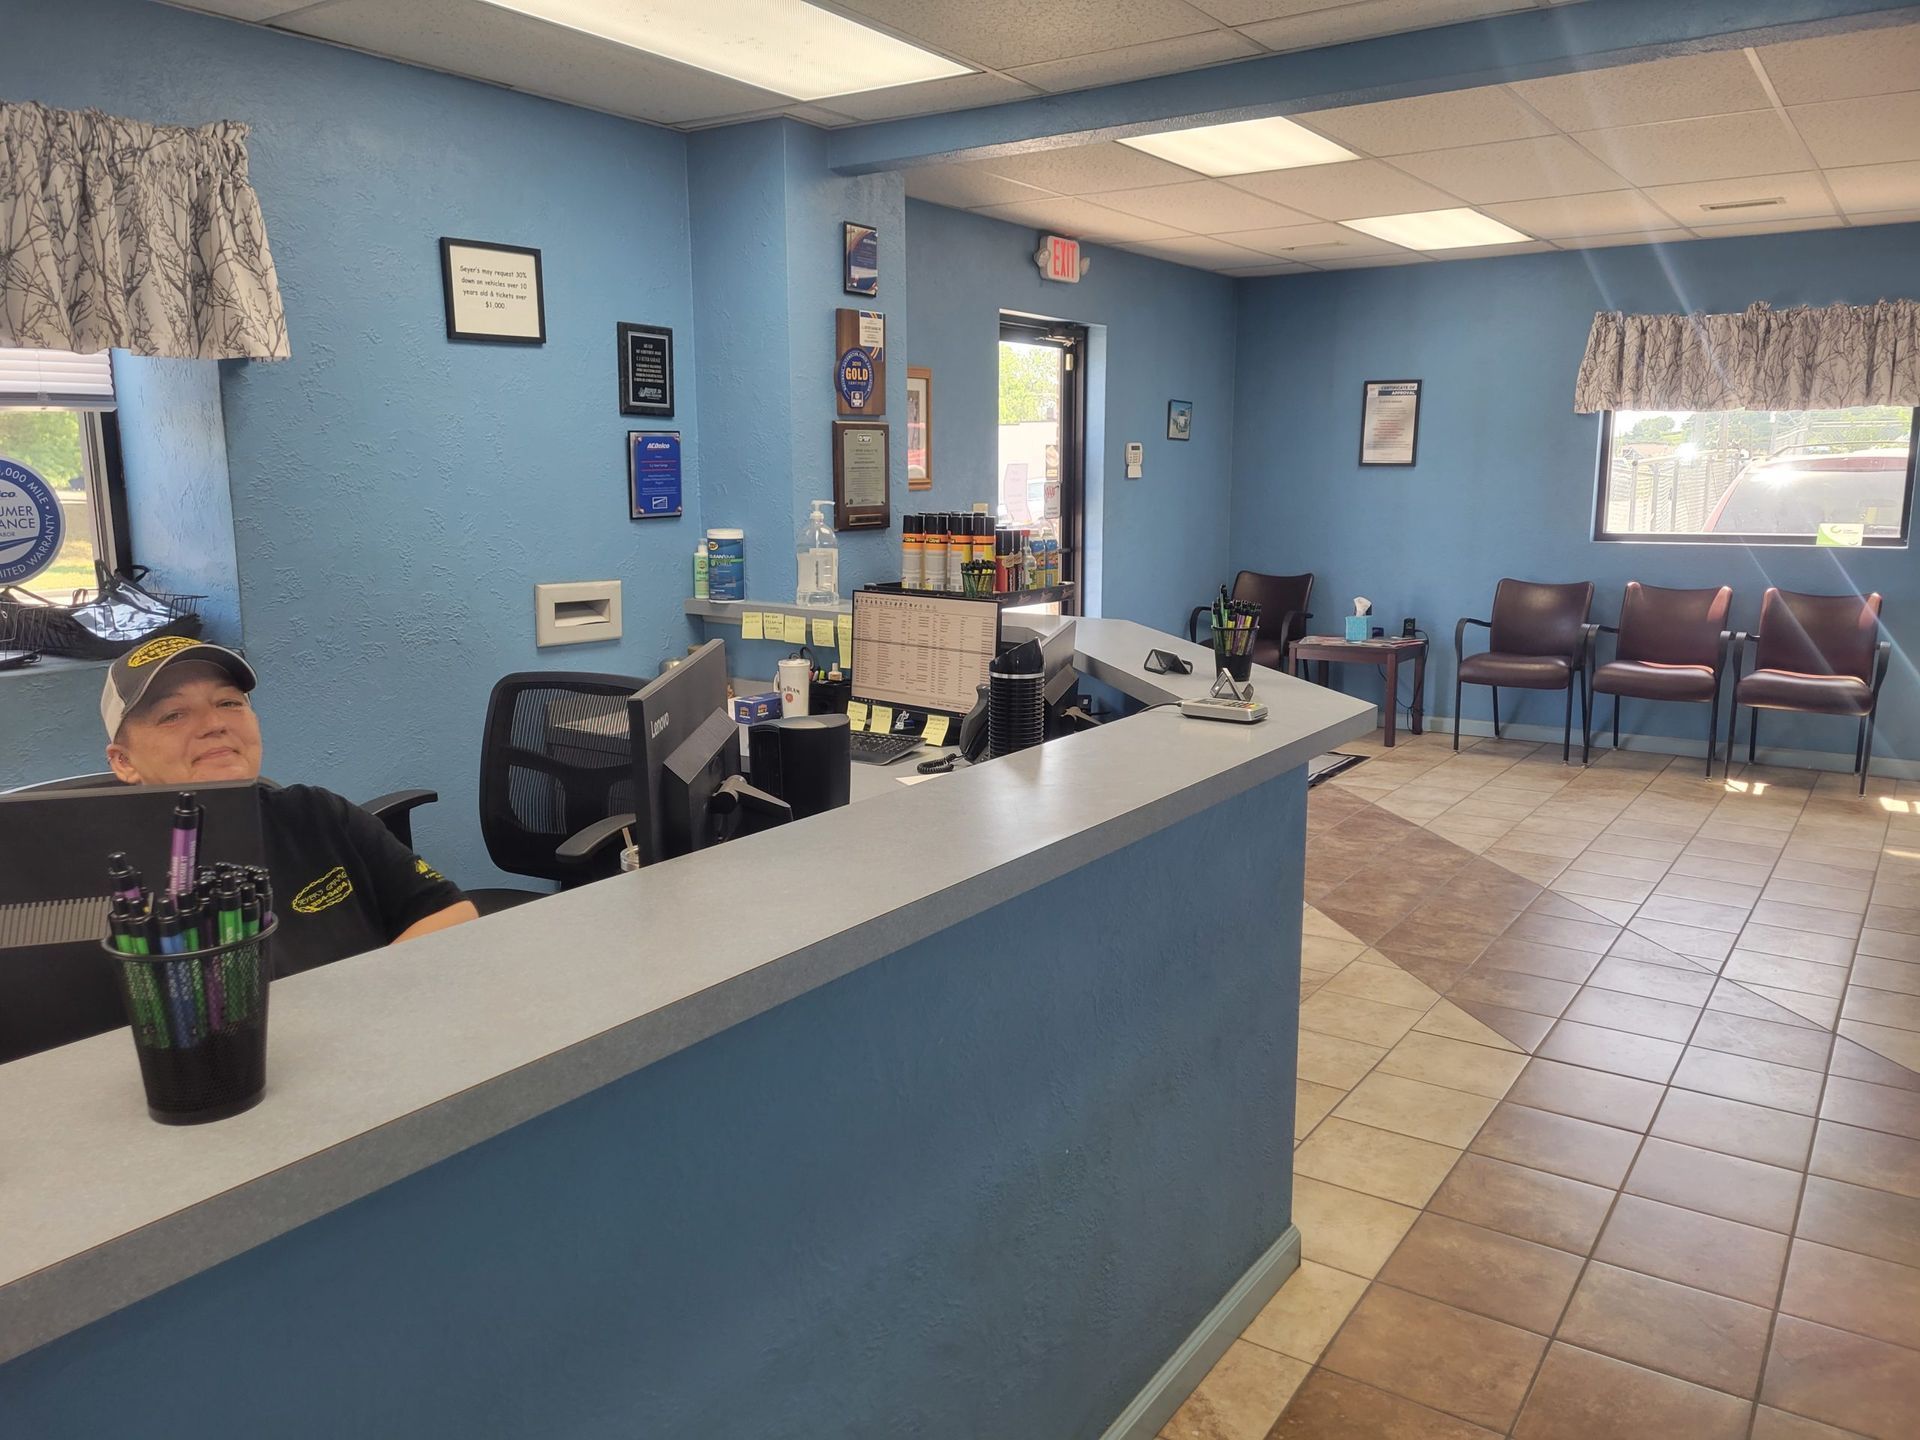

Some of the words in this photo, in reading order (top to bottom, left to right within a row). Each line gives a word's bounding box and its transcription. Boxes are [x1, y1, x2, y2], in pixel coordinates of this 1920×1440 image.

[1053, 239, 1076, 279] EXIT
[485, 301, 506, 309] $1,000
[845, 367, 868, 381] GOLD
[0, 467, 27, 483] ,000
[27, 482, 49, 504] MILE
[26, 514, 55, 566] WARRANTY
[650, 711, 670, 739] Lenovo
